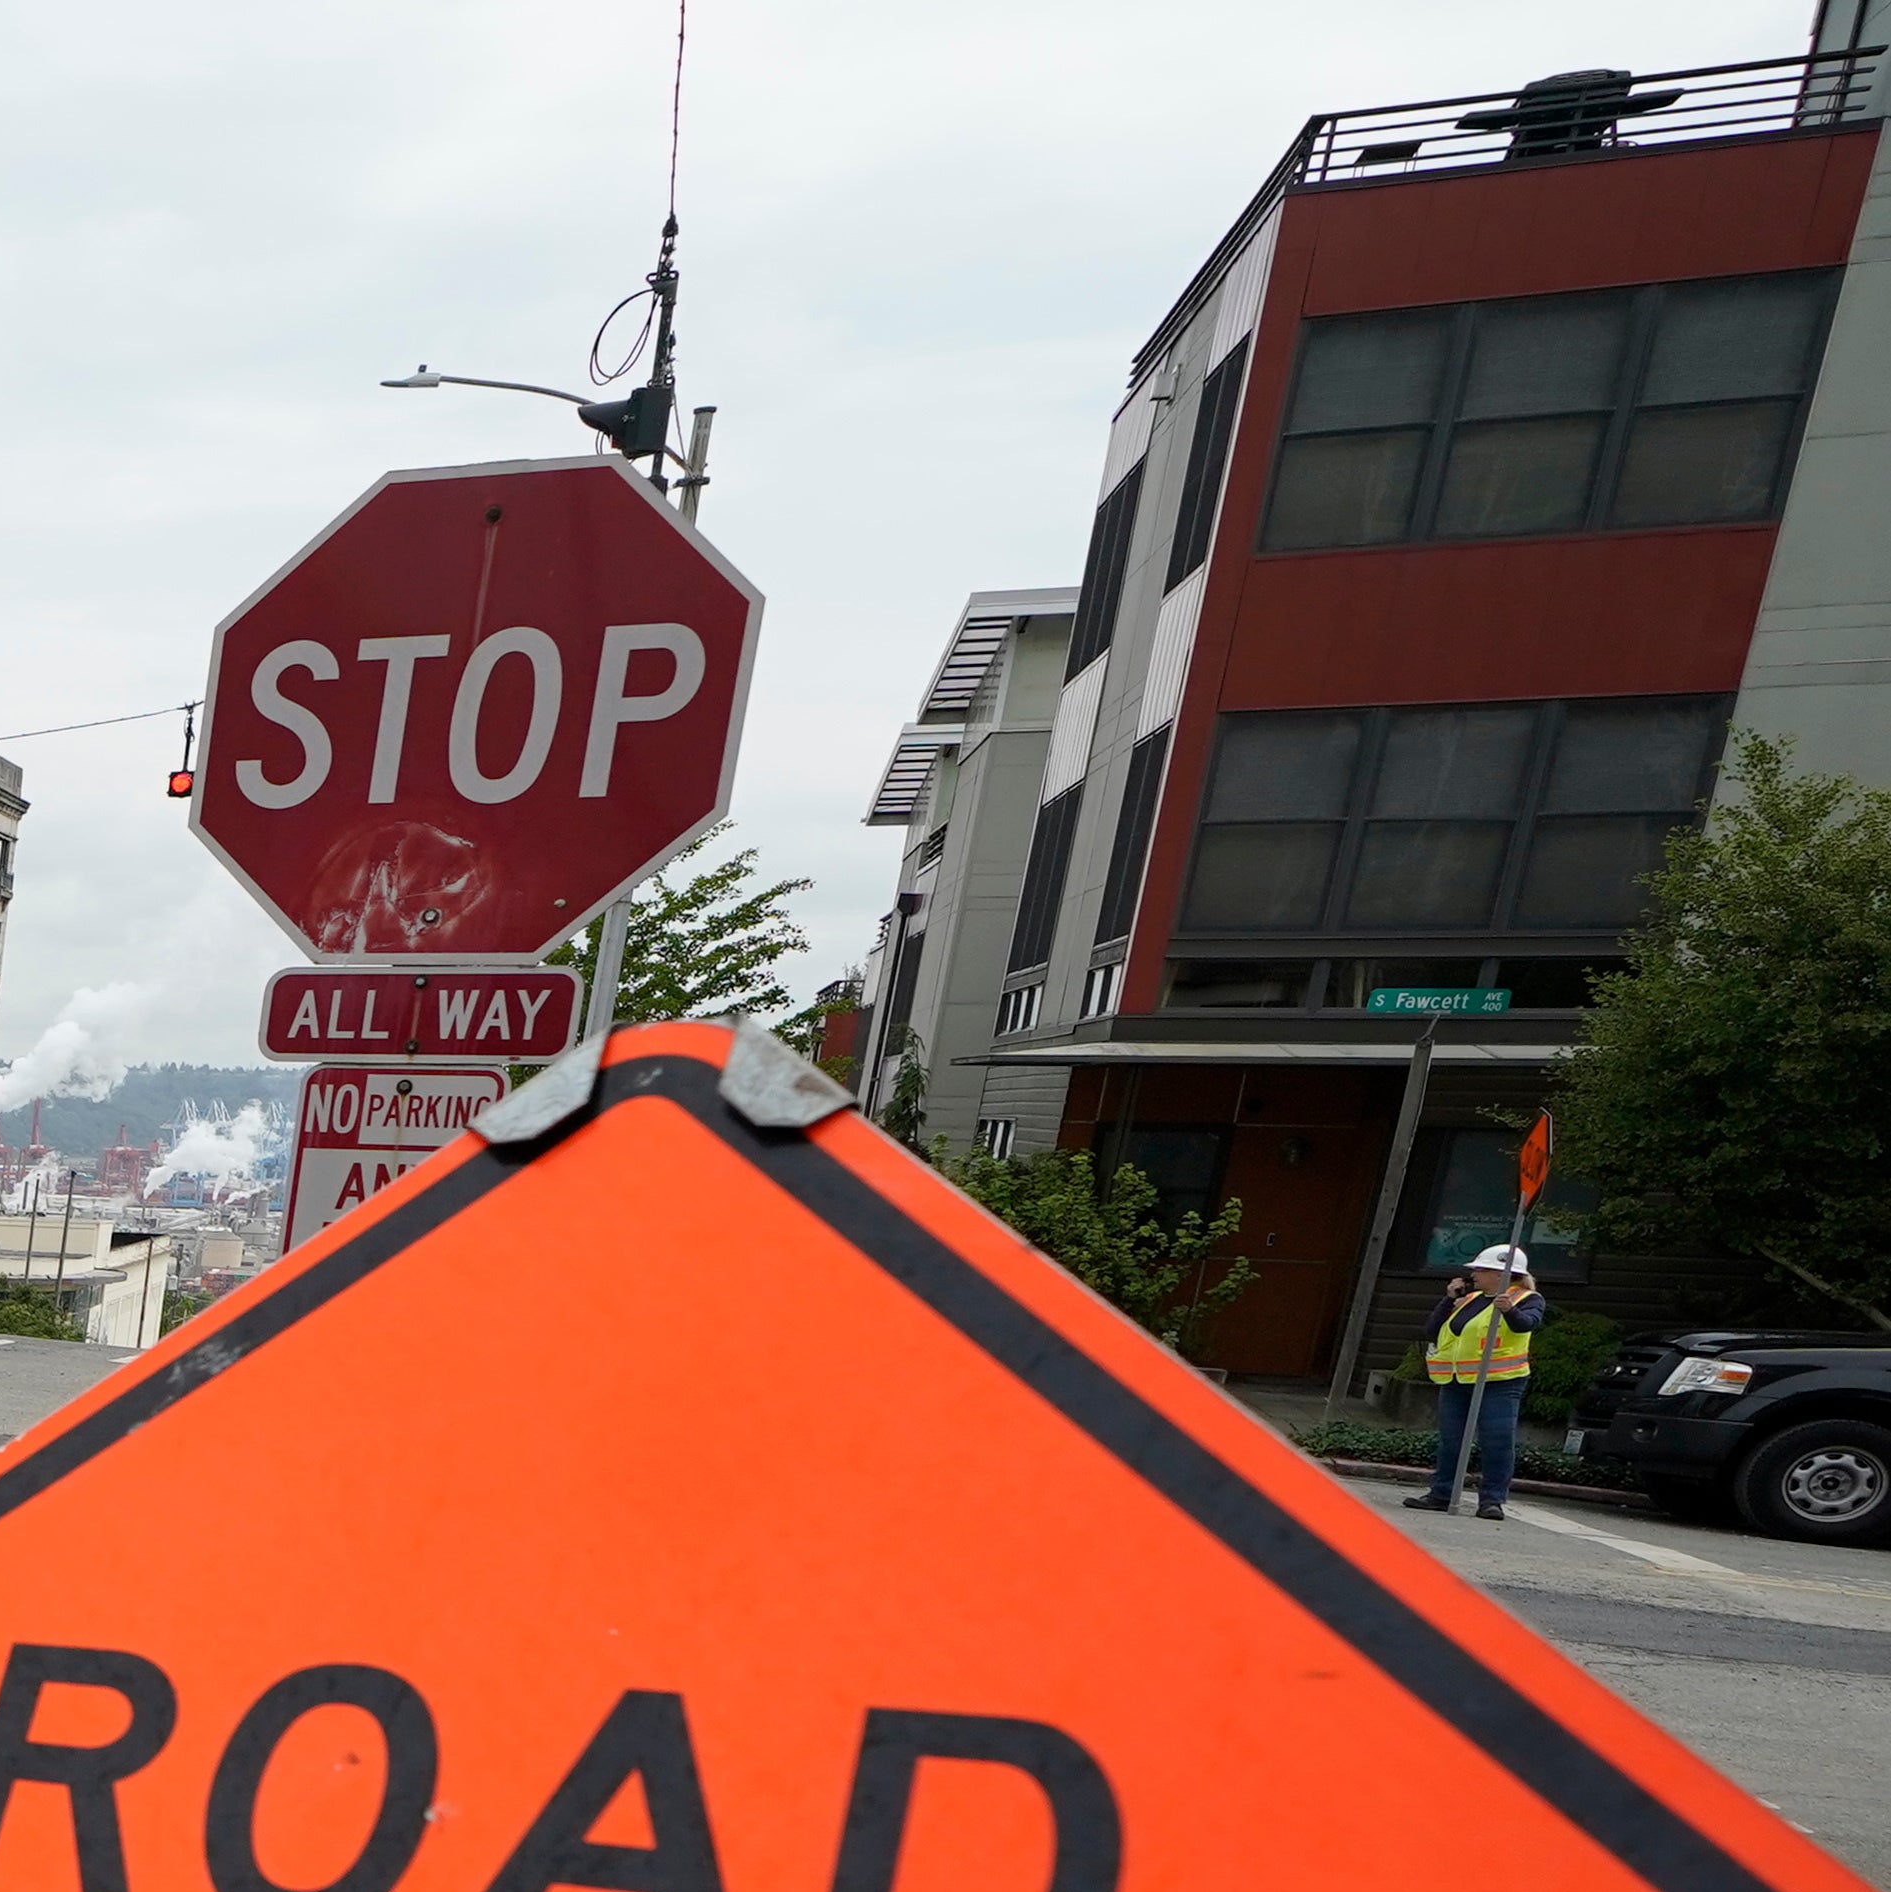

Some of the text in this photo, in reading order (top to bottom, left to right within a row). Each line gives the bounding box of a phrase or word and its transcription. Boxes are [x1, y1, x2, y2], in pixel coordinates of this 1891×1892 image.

[235, 622, 706, 810] STOP
[1375, 992, 1470, 1009] S Fawcett
[1481, 1002, 1502, 1011] 400
[1483, 992, 1504, 1001] AVE
[287, 989, 553, 1040] ALL WAY
[304, 1083, 360, 1133] NO
